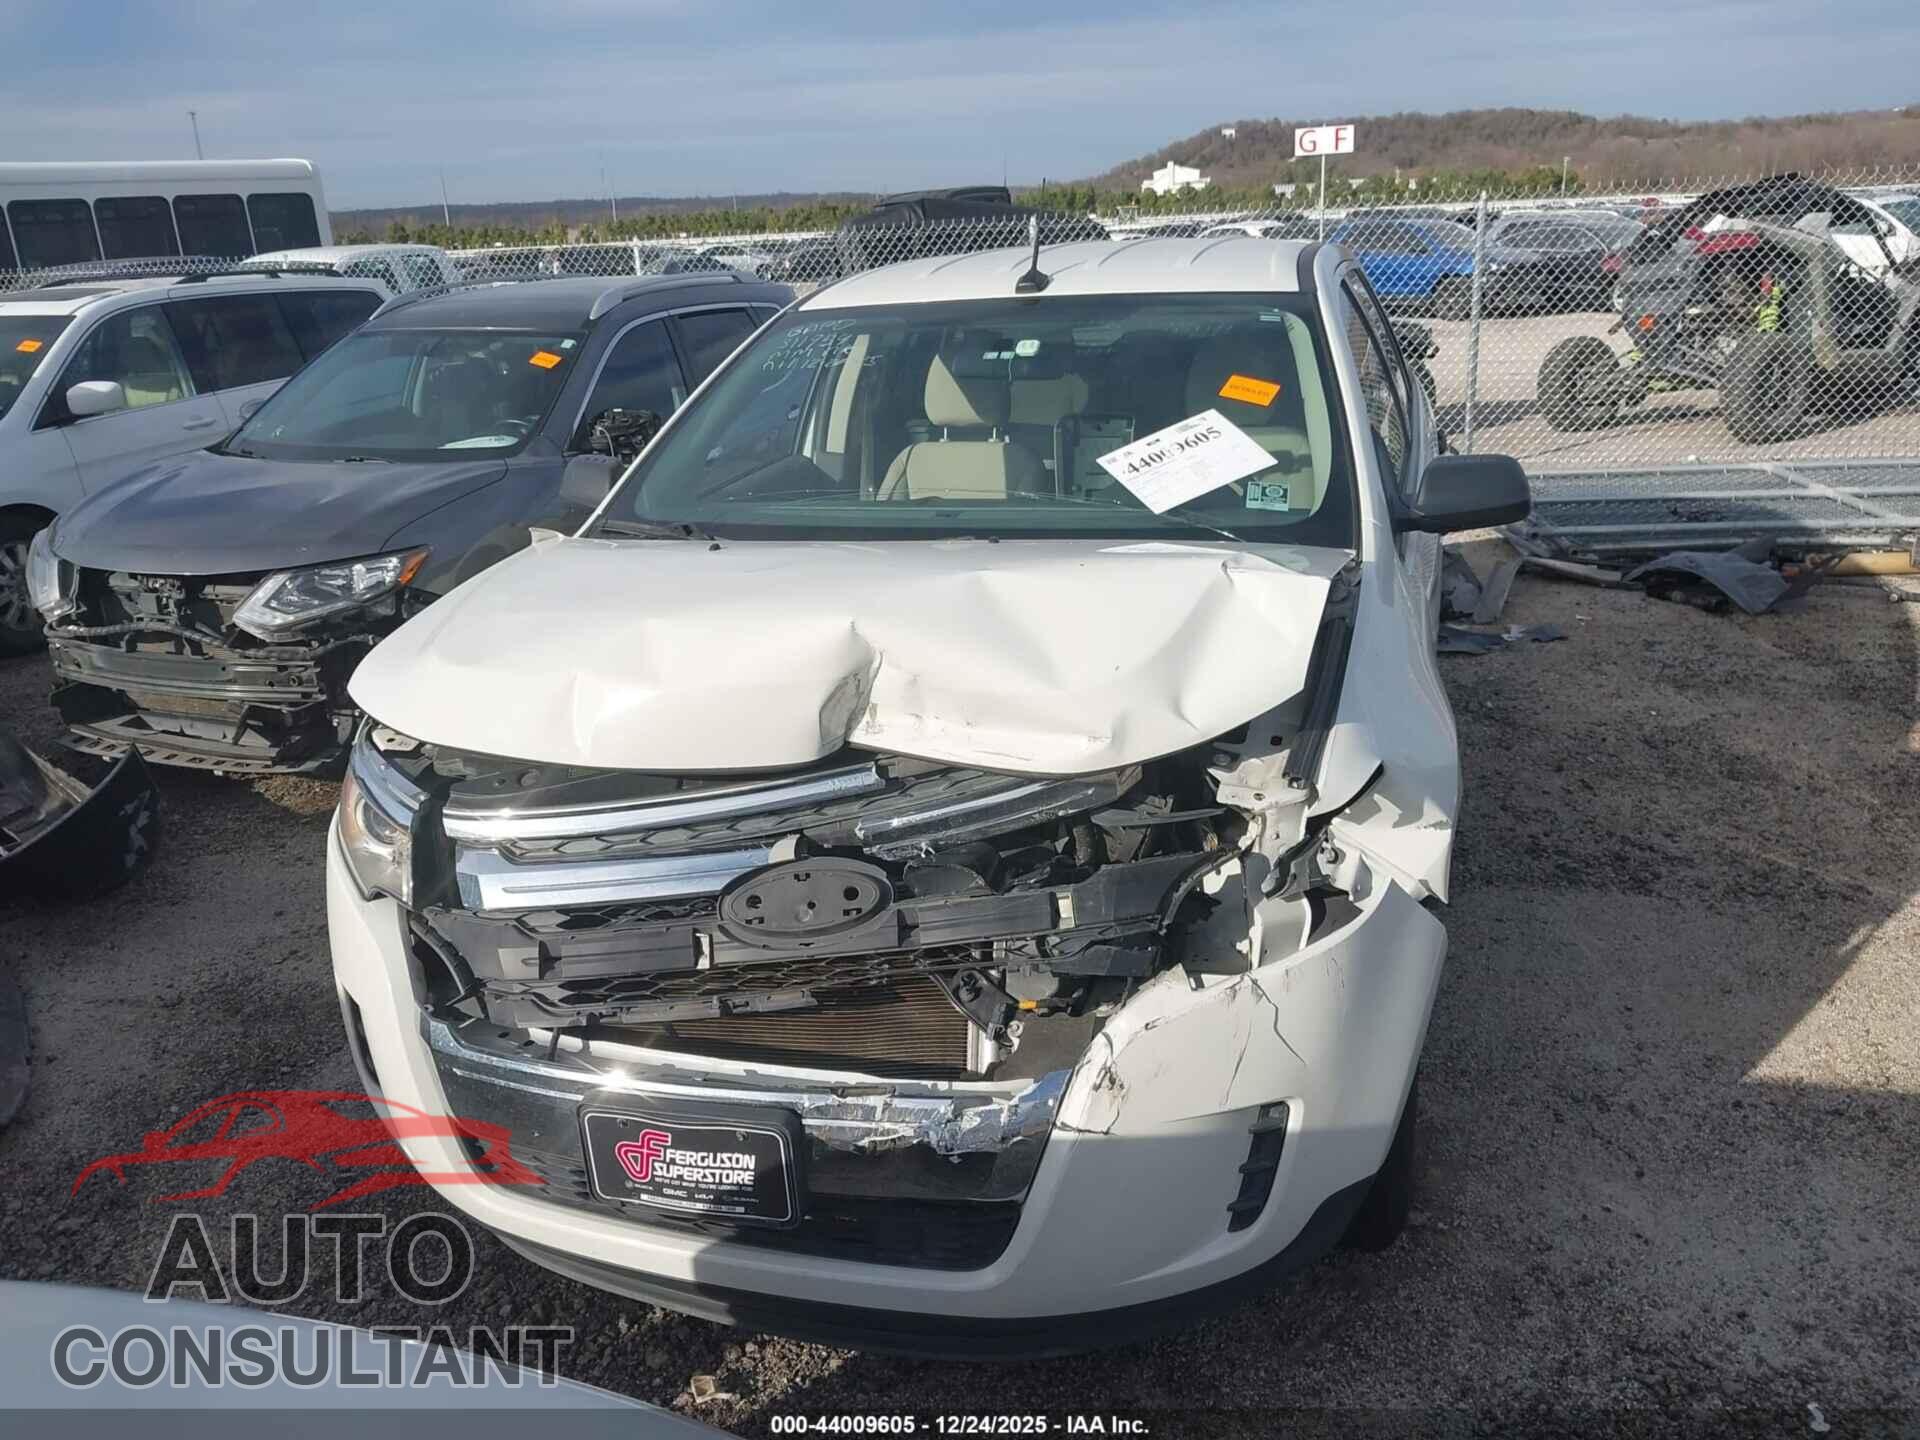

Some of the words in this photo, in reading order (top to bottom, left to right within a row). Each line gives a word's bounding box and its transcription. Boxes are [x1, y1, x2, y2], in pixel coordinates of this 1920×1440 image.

[1299, 129, 1317, 153] G
[1335, 127, 1347, 151] F
[665, 1148, 756, 1170] FERGUSON
[653, 1162, 755, 1185] SUPERSTORE
[663, 1188, 688, 1198] GMC
